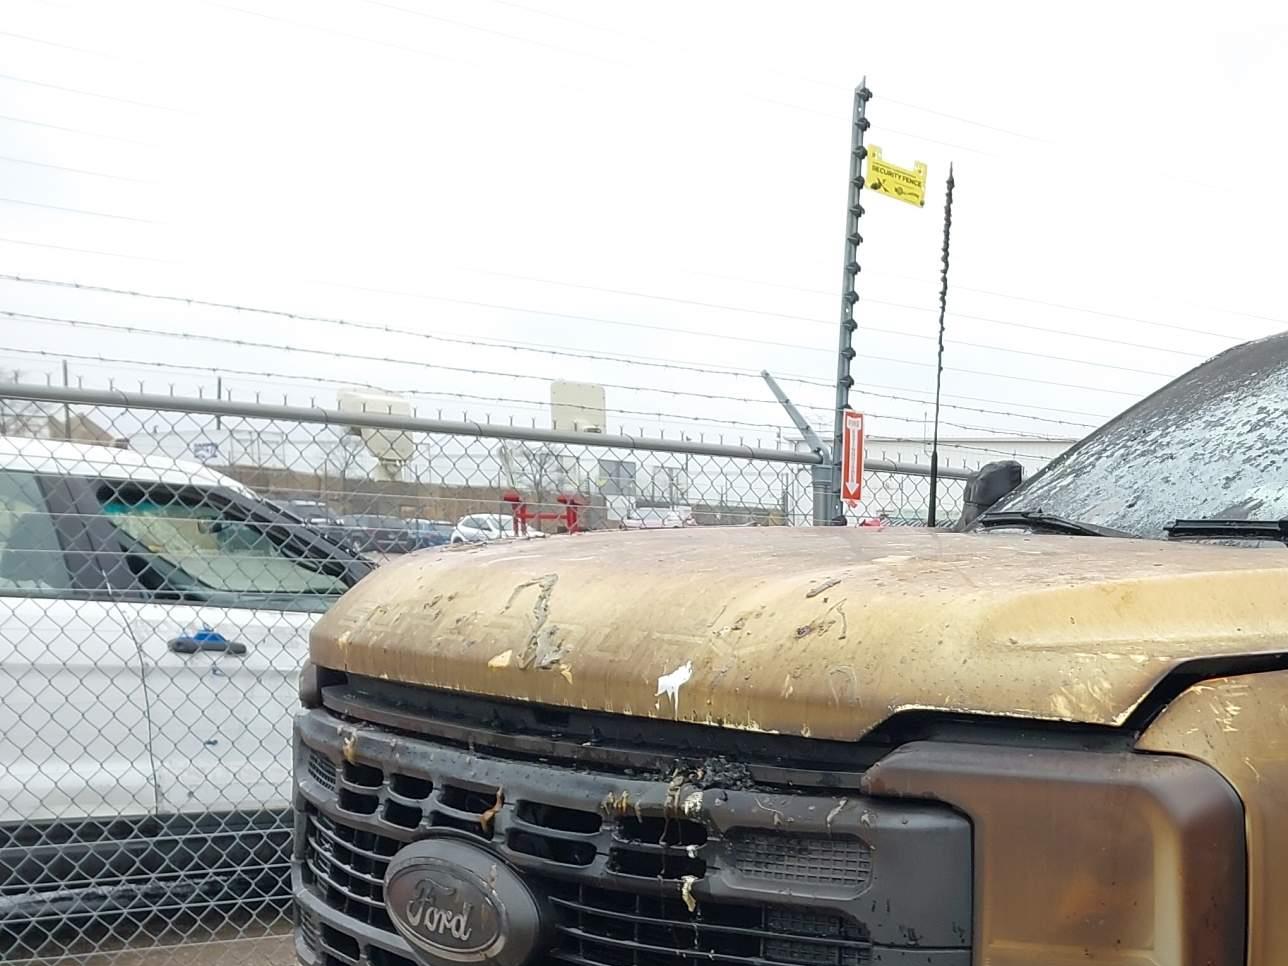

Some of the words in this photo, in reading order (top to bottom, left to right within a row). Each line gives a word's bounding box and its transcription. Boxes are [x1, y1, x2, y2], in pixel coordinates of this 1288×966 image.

[871, 164, 902, 181] SECURITY
[902, 176, 922, 188] FENCE
[405, 878, 472, 942] Ford
